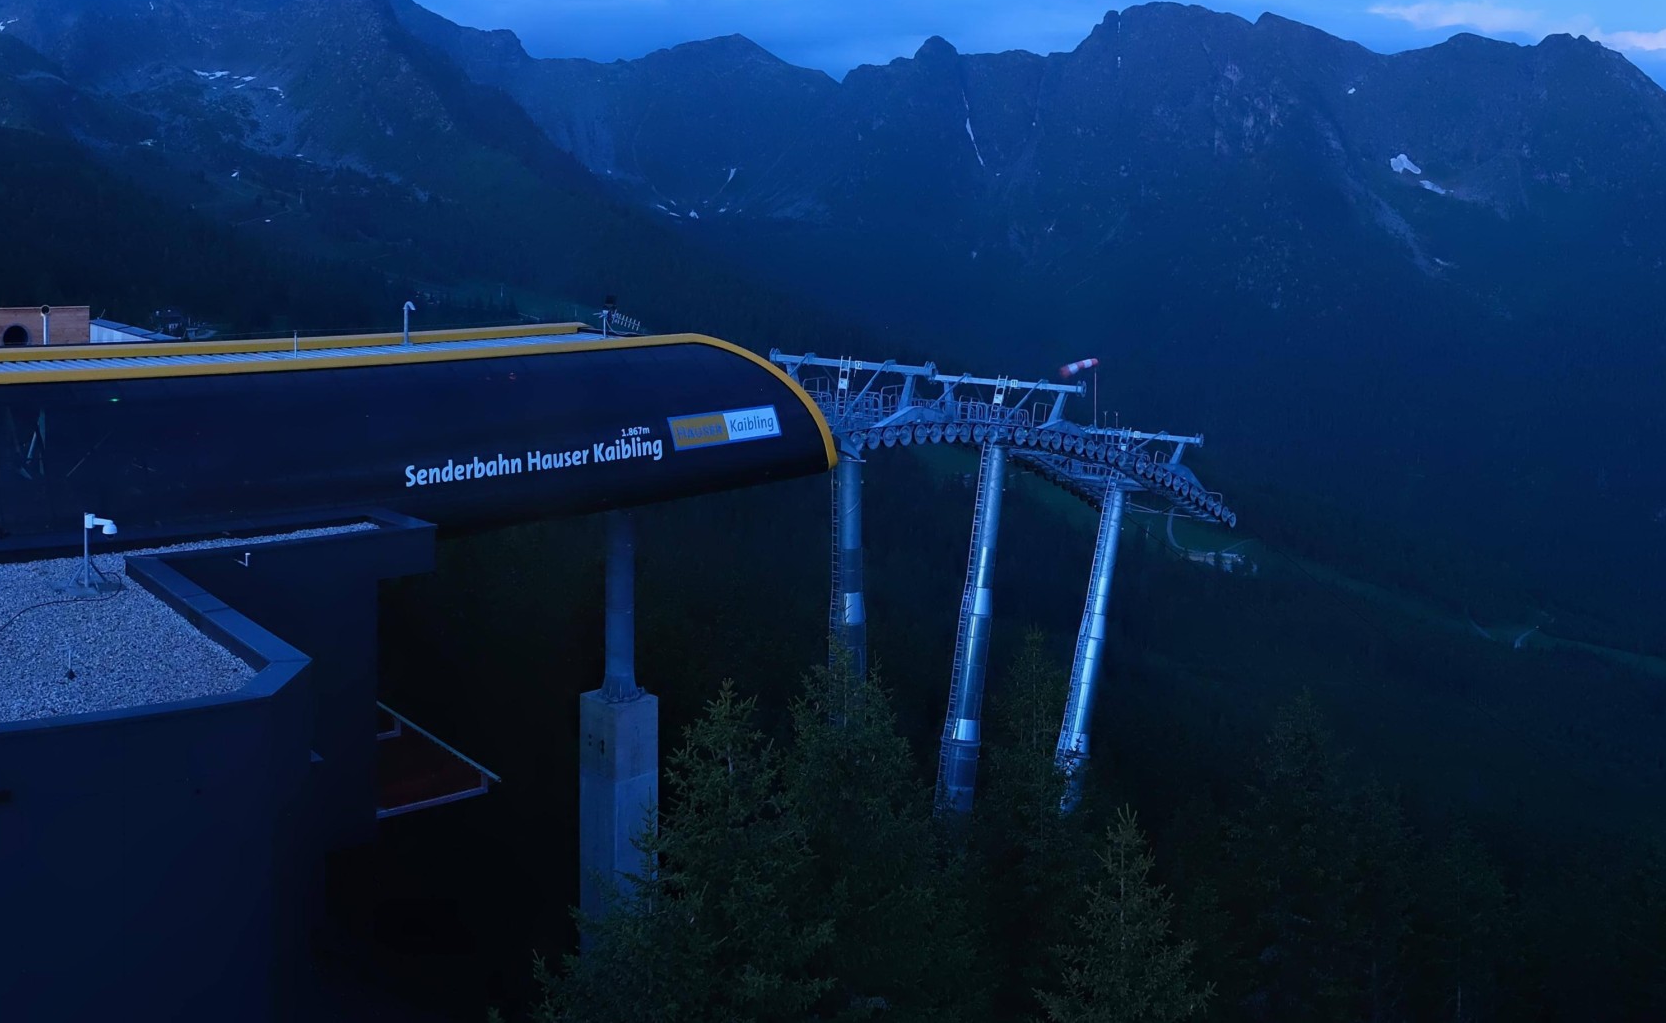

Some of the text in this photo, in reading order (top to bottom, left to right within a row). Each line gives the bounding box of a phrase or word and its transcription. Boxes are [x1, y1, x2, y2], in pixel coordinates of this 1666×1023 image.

[621, 426, 650, 437] 1.867m
[729, 413, 774, 432] Kaibling
[405, 437, 663, 488] Senderbahn Hauser Kaibling
